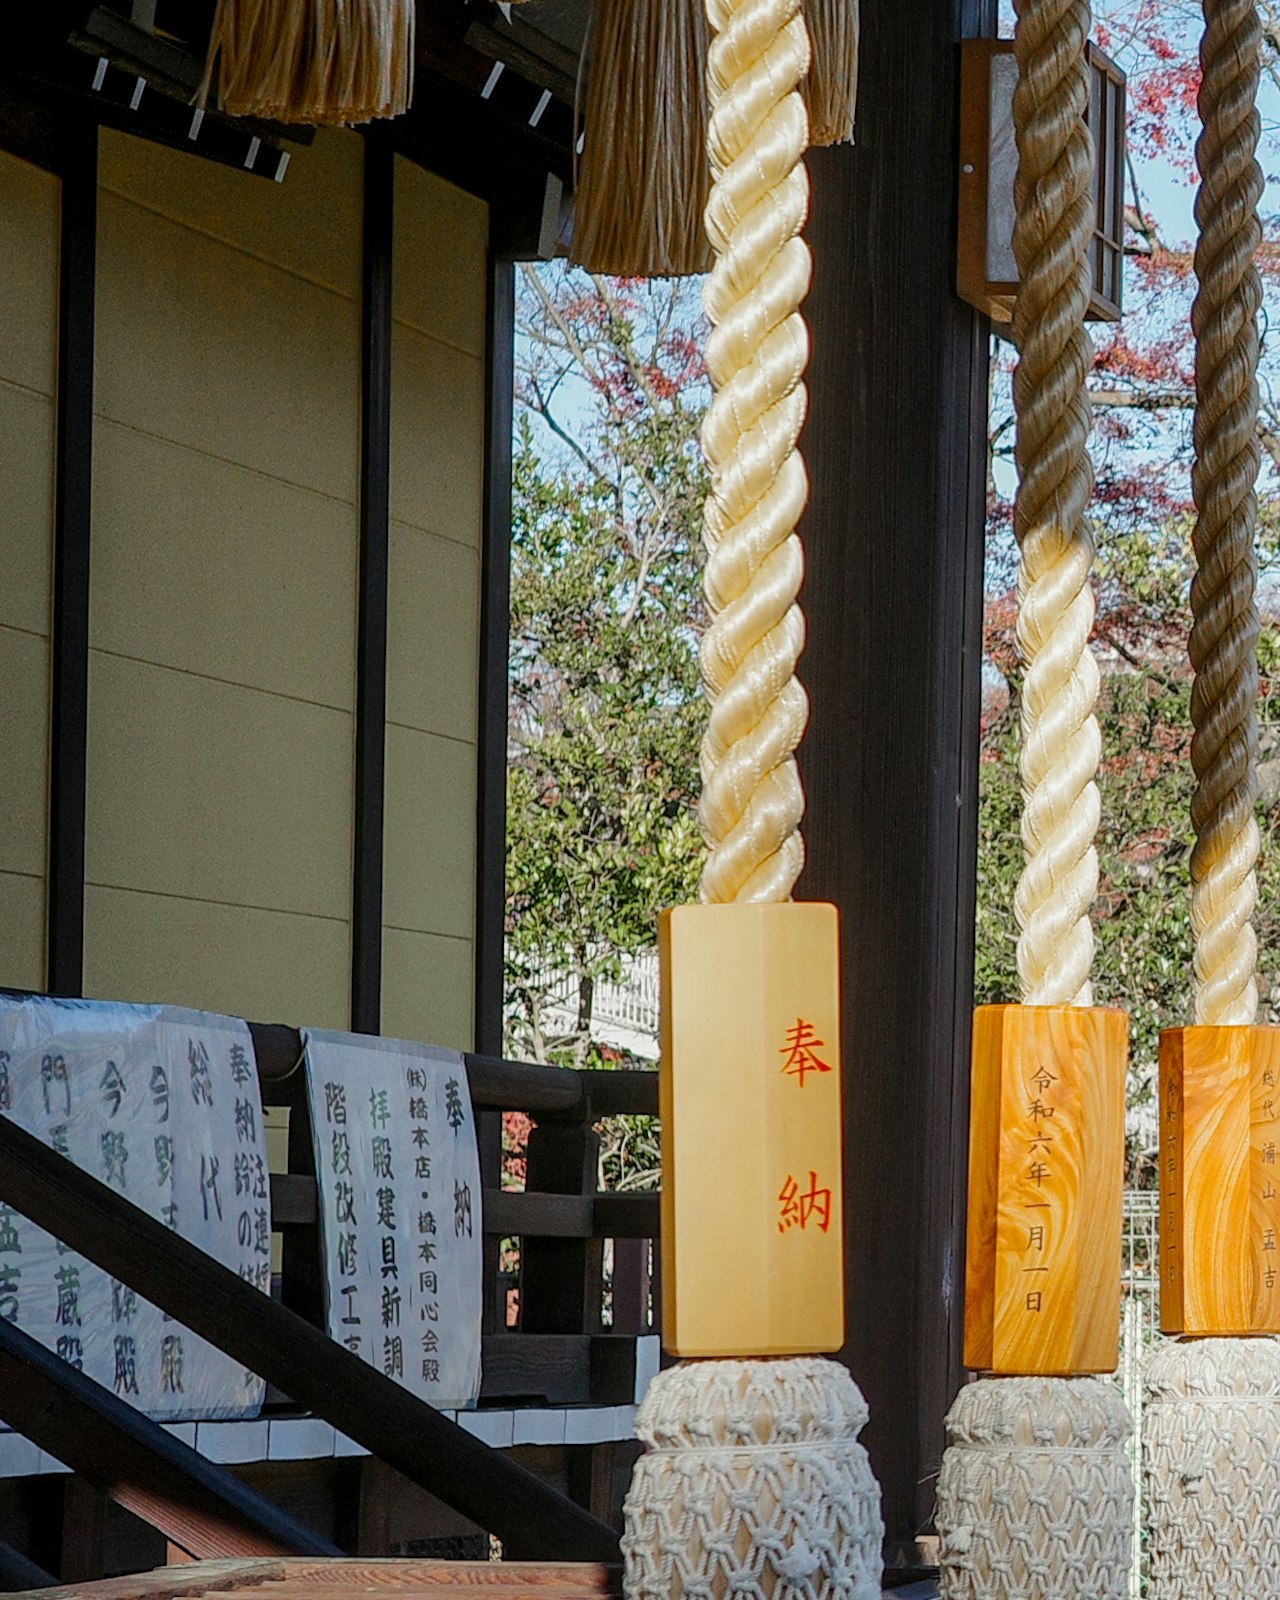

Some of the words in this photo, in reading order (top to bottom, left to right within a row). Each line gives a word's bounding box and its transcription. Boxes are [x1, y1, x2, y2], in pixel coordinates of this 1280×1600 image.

[369, 1086, 404, 1379] 拝殿建具新調
[445, 1075, 472, 1239] 奉納
[778, 1016, 833, 1235] 奉納
[1021, 1064, 1058, 1313] 令和六年一月一日
